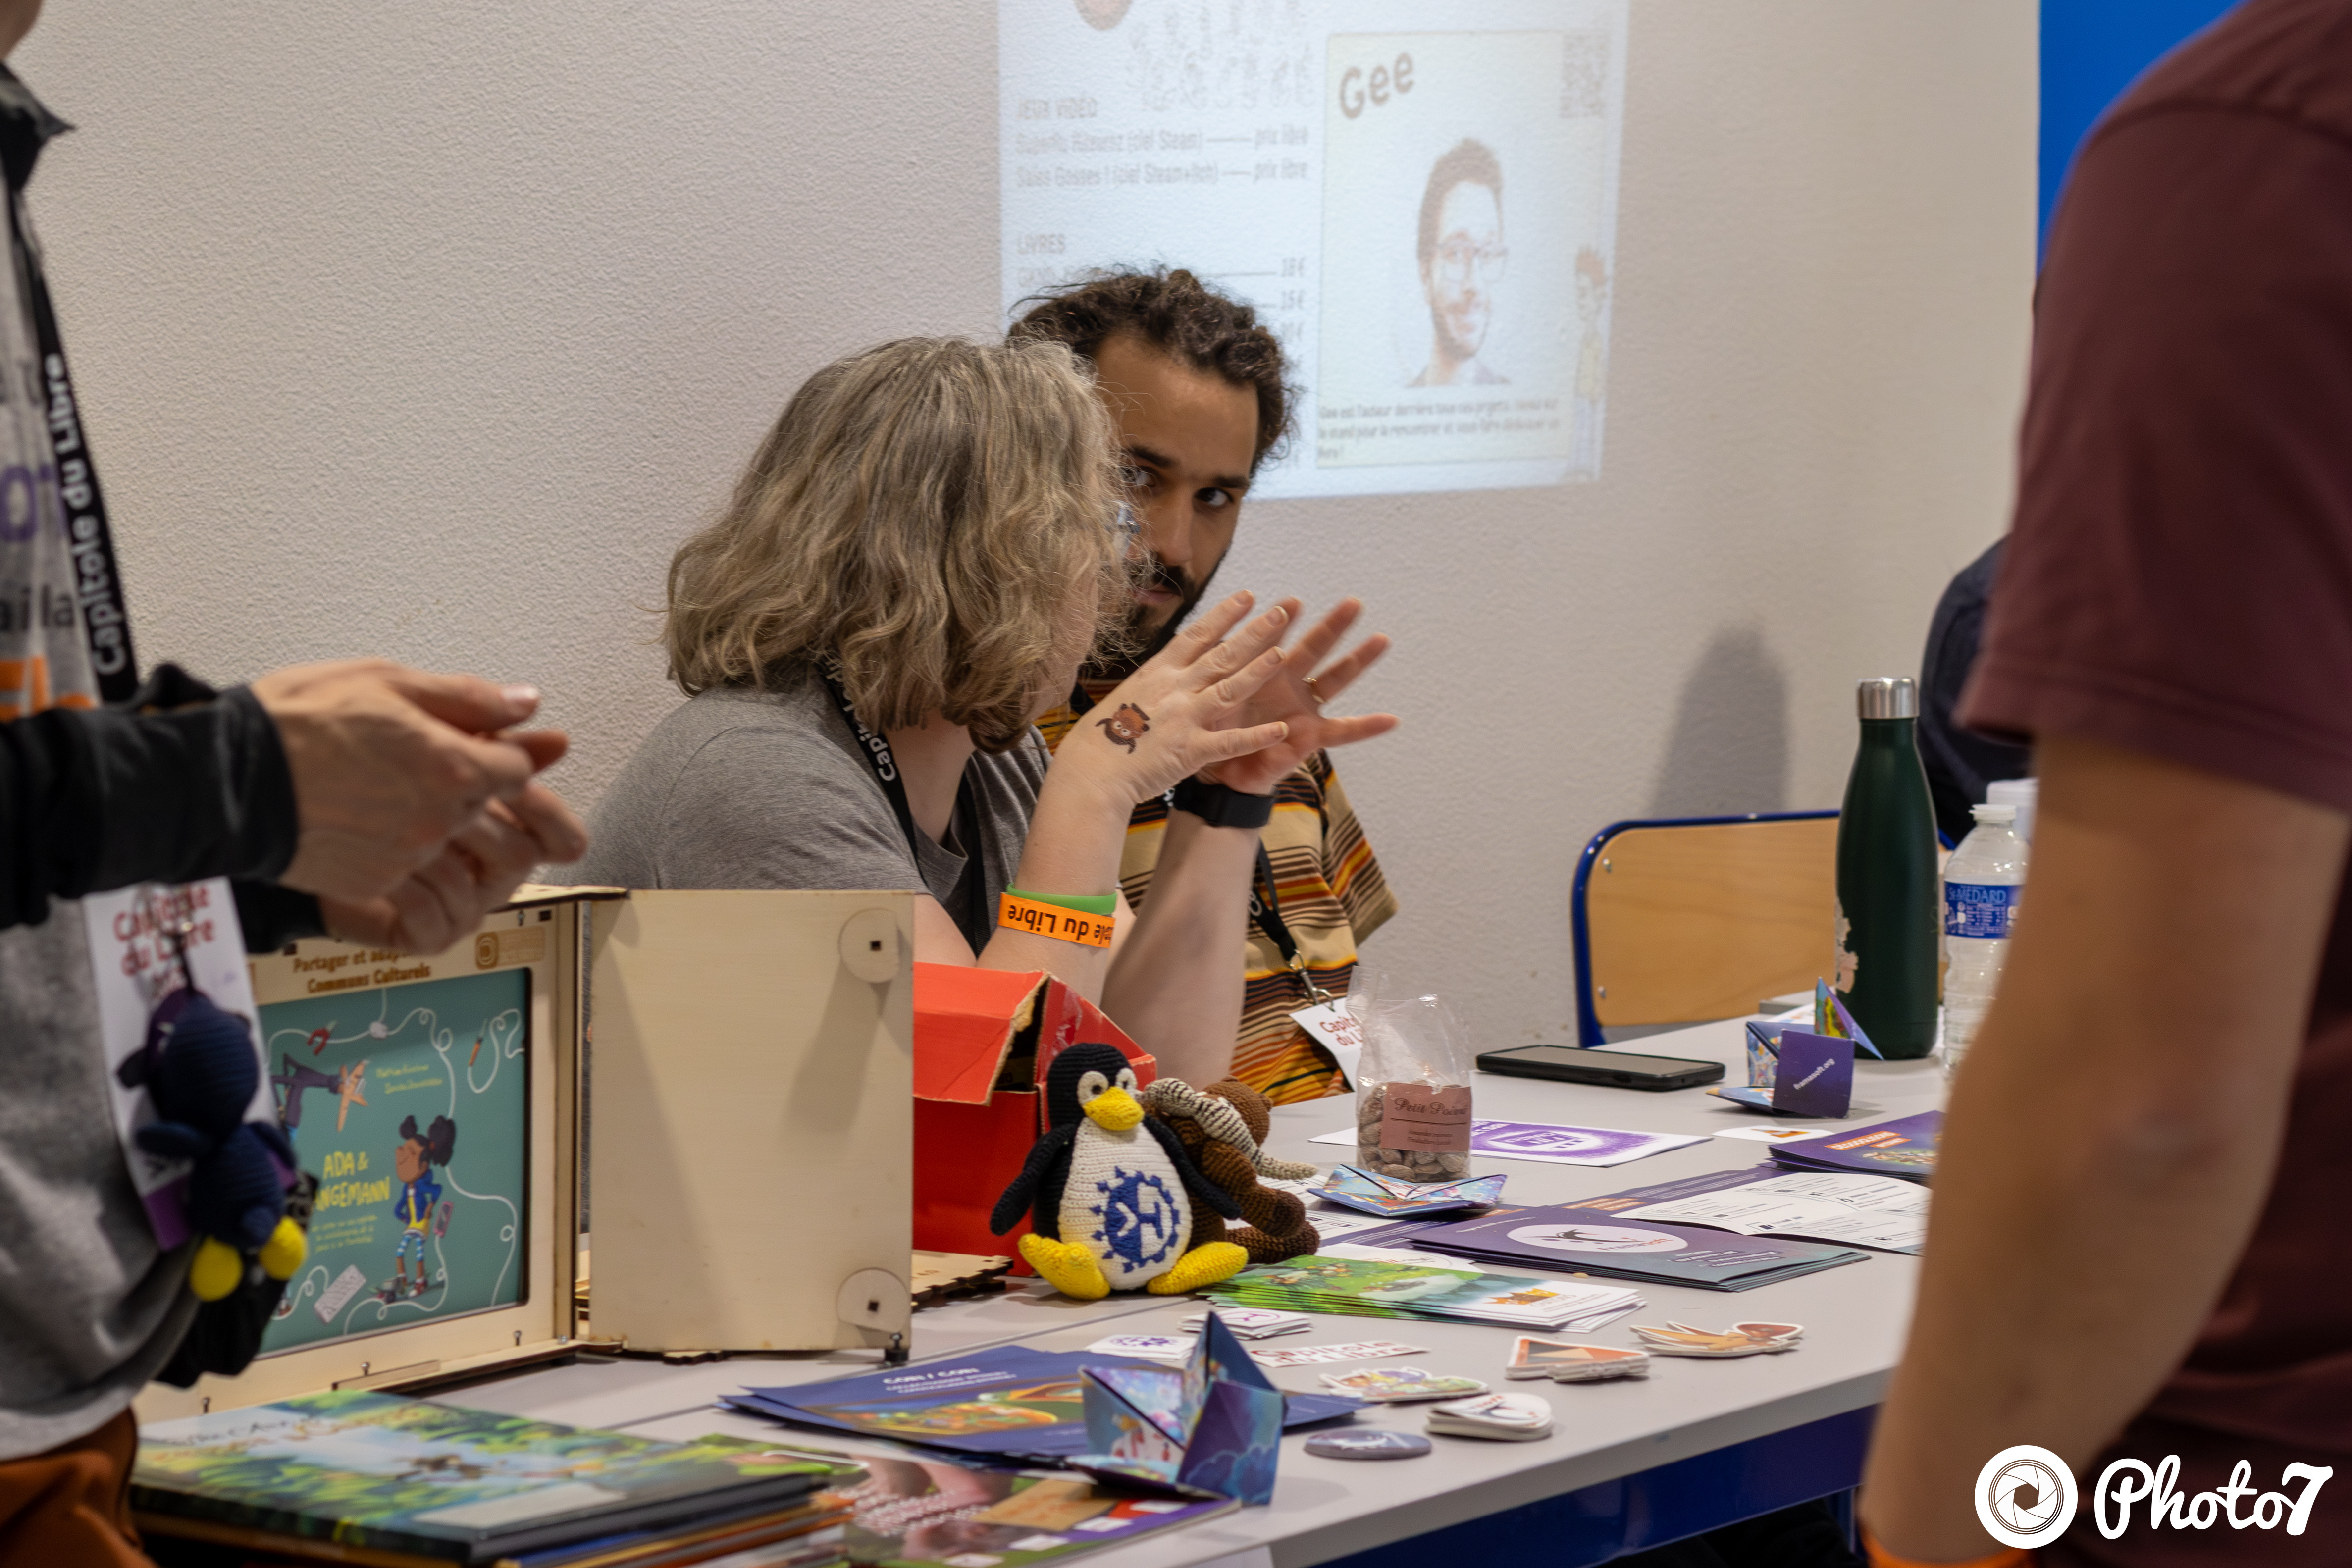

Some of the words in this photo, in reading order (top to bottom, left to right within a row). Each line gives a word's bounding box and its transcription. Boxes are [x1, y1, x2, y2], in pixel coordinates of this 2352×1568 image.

[1340, 52, 1415, 119] Gee
[1017, 232, 1066, 255] LIVRES
[45, 352, 81, 454] Libre
[61, 458, 93, 511] du
[71, 515, 126, 676] Capitole
[1007, 905, 1057, 933] Libre
[1064, 918, 1089, 941] du
[352, 950, 367, 965] et
[1335, 1033, 1355, 1046] du
[1394, 1098, 1426, 1113] Petit
[323, 1150, 356, 1181] ADA
[357, 1151, 370, 1171] &
[1596, 1239, 1674, 1251] Framasoft
[1250, 1342, 1397, 1358] Capitole
[1321, 1346, 1414, 1360] Libre
